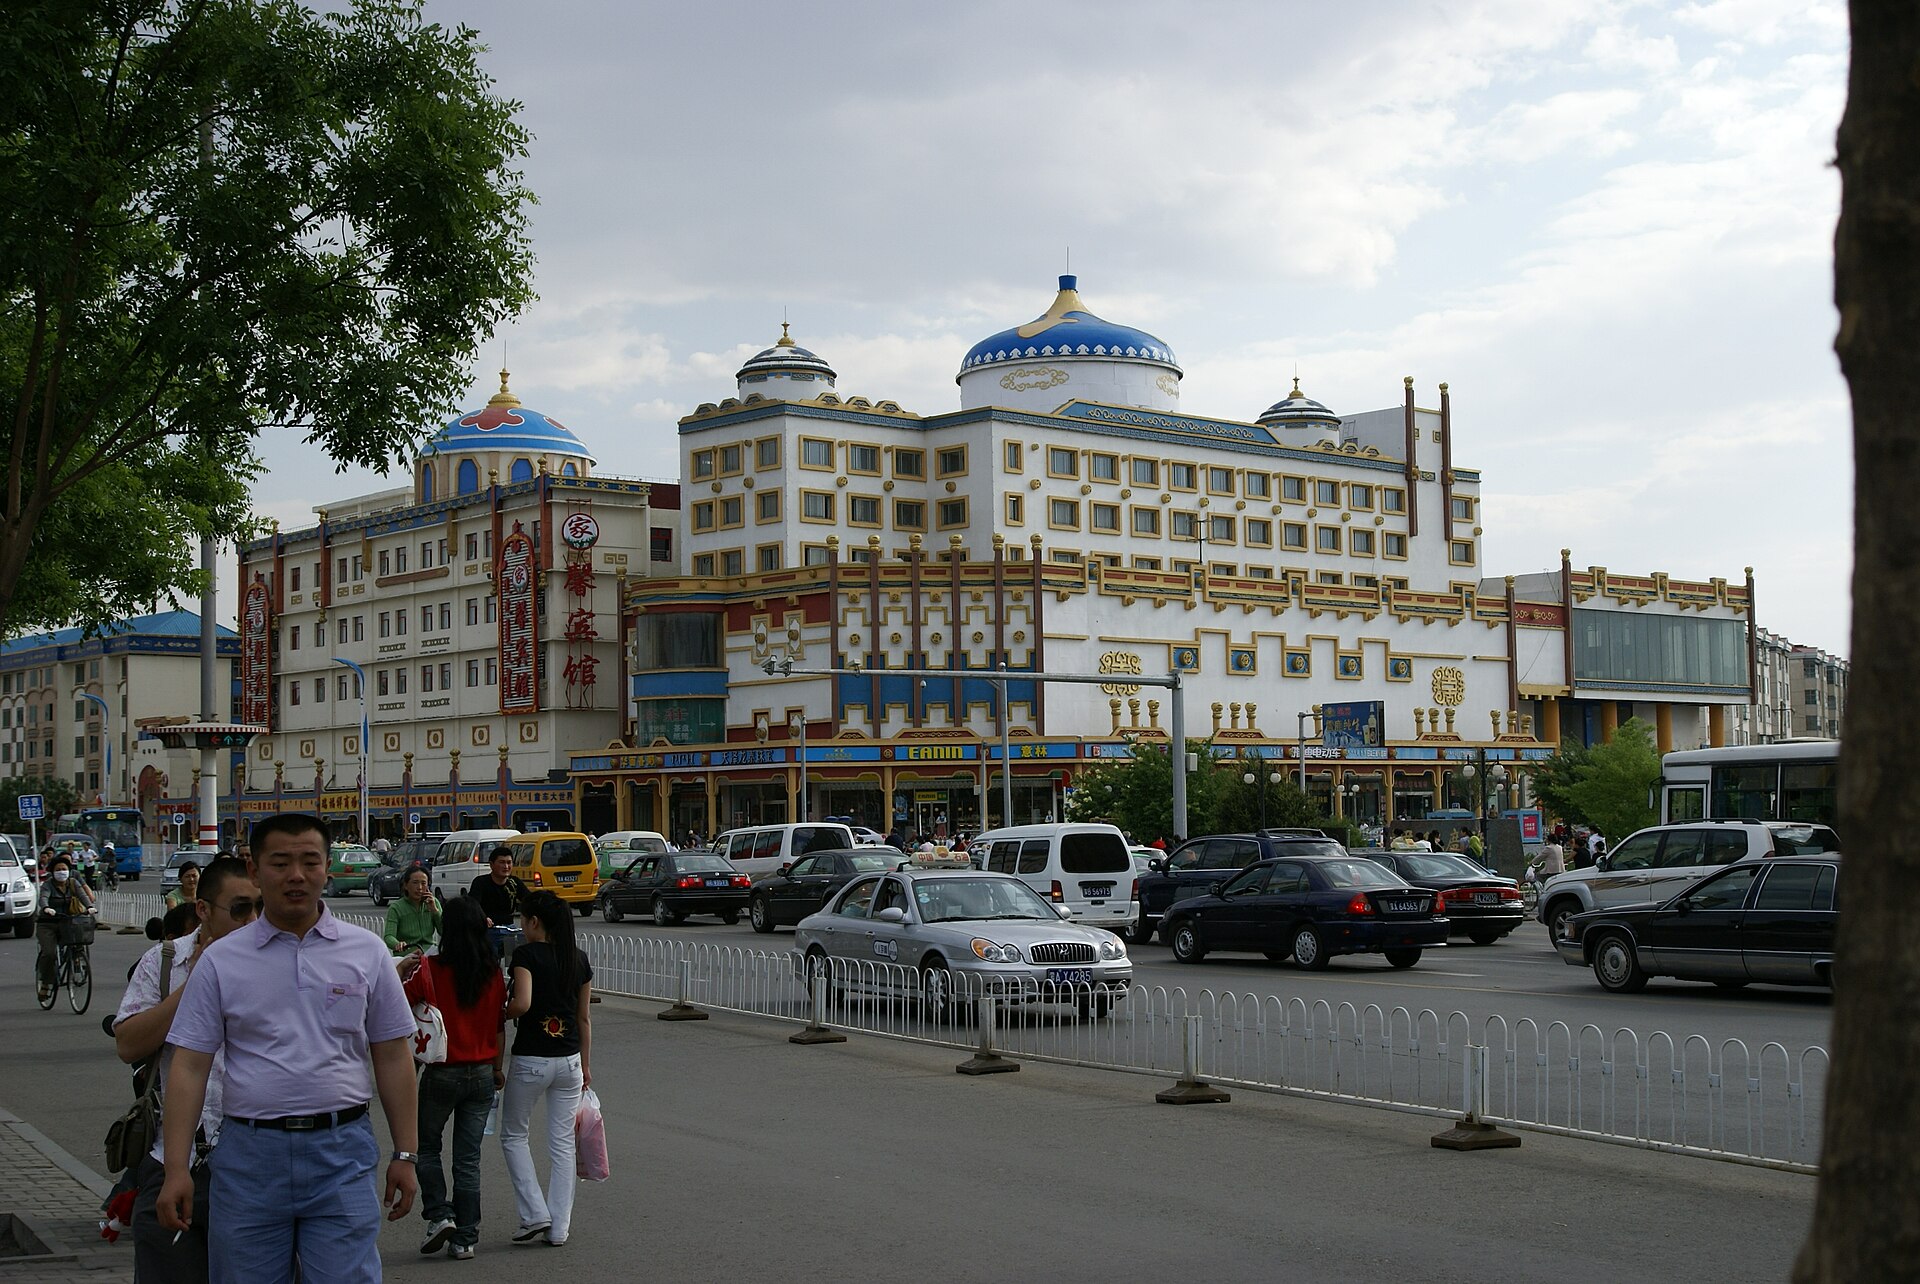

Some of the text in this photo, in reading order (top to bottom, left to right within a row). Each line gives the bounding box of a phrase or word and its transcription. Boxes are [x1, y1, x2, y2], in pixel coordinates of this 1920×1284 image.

[908, 745, 964, 760] EANIN
[1020, 745, 1047, 758] 意林
[21, 797, 40, 808] 注意
[918, 853, 934, 863] 中国
